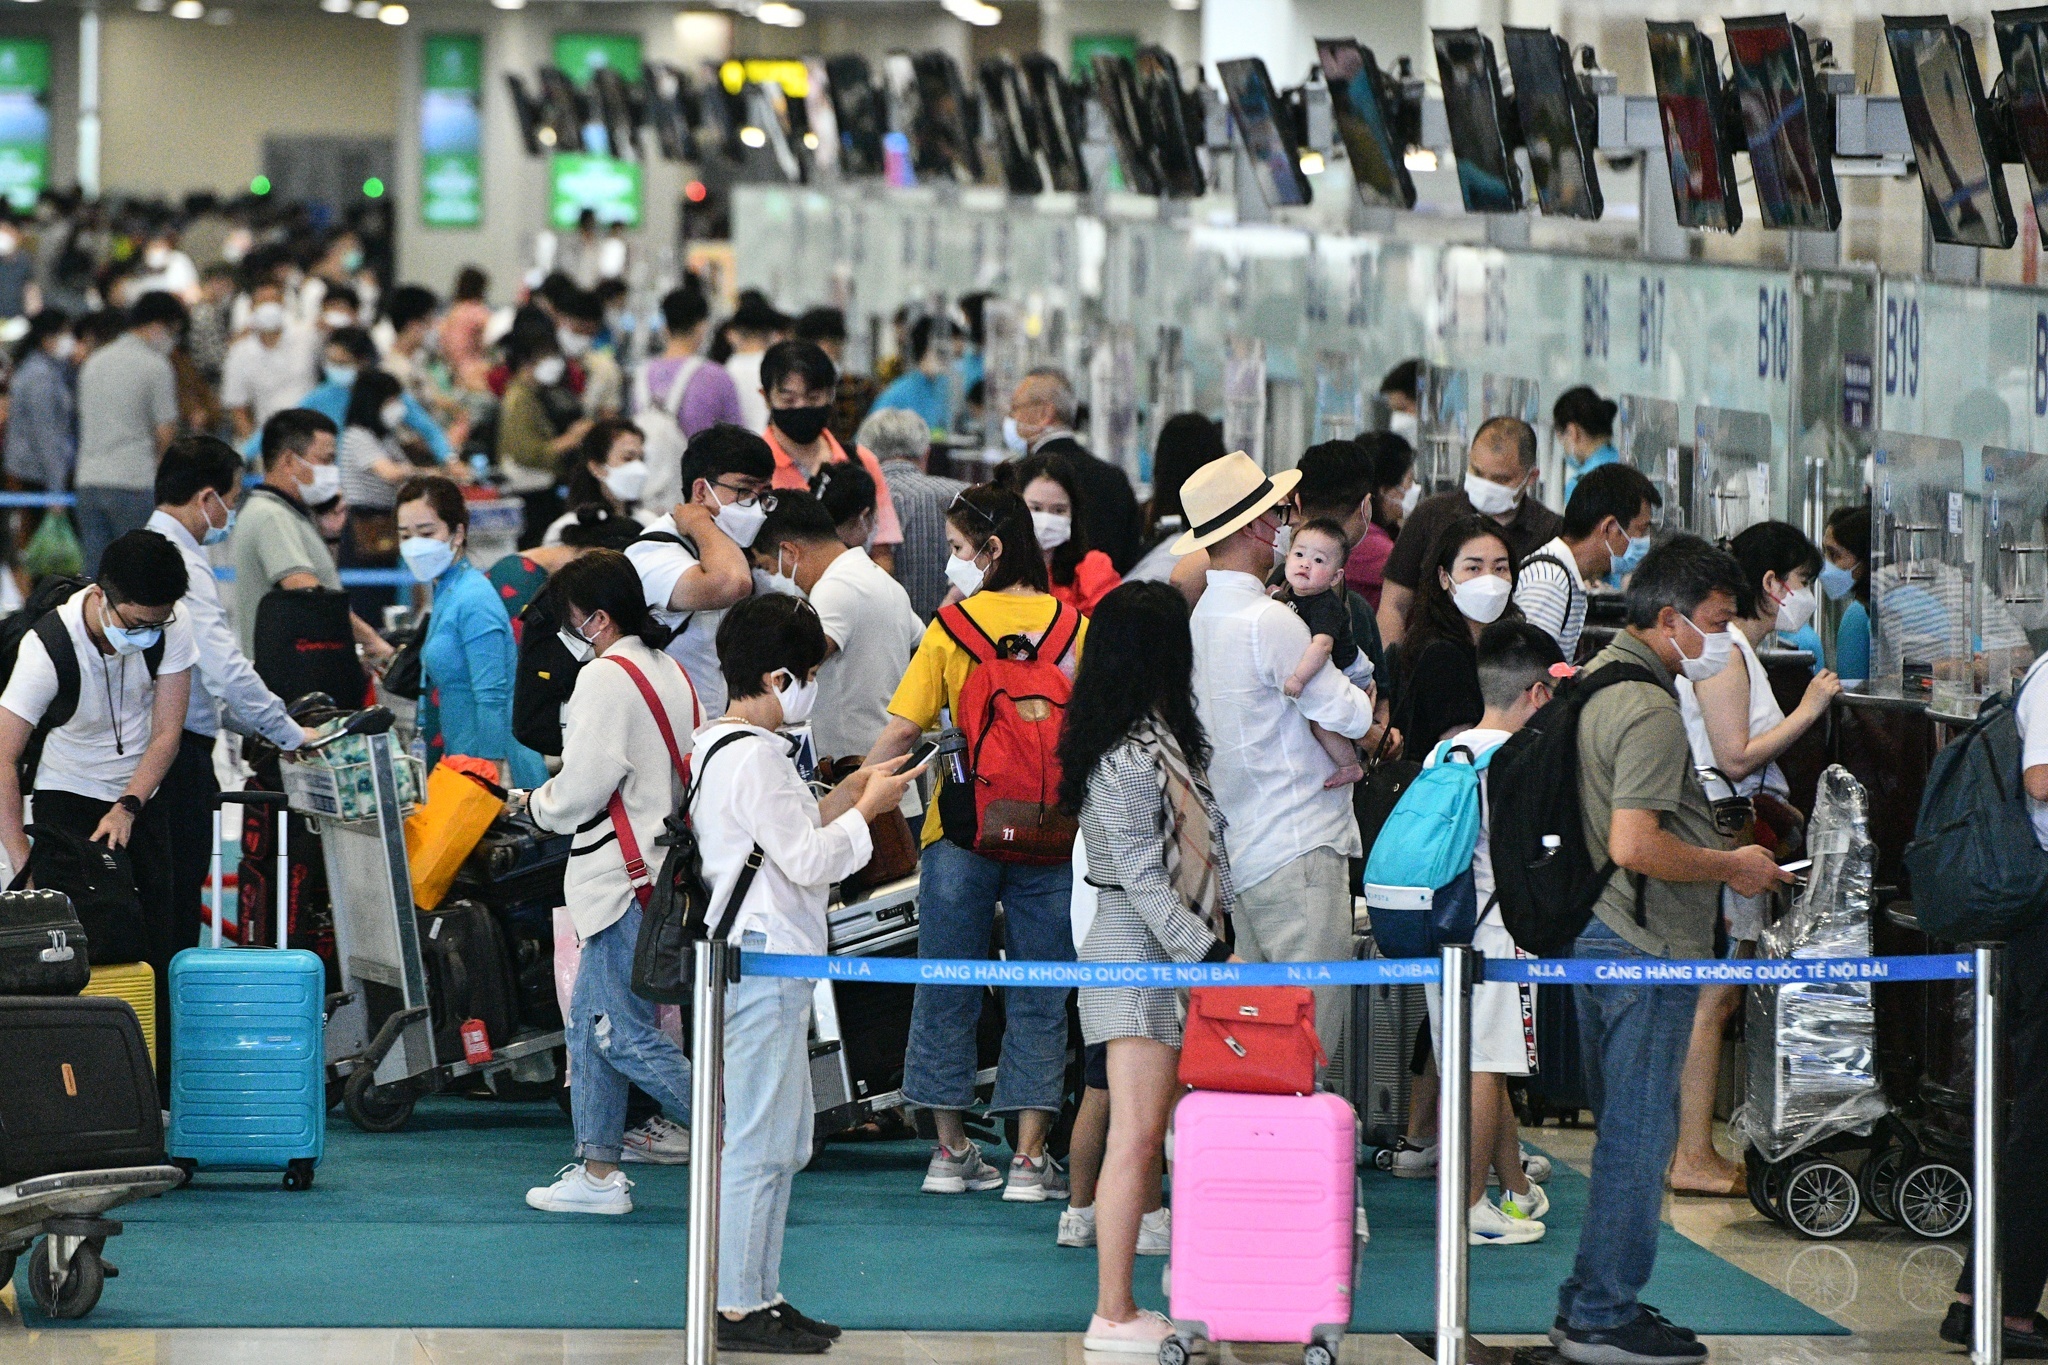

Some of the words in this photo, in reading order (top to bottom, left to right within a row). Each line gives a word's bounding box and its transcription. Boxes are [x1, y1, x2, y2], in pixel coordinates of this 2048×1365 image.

[1639, 275, 1666, 366] B17
[1758, 286, 1788, 383] B18
[1886, 296, 1920, 398] B19
[828, 961, 872, 977] N.I.A
[1287, 965, 1332, 980] N.I.A
[1527, 963, 1567, 978] N.I.A
[1695, 963, 1752, 980] KHÔNG
[1829, 962, 1859, 981] NỘI
[1520, 993, 1532, 1020] FILA
[1526, 1042, 1537, 1068] FILA
